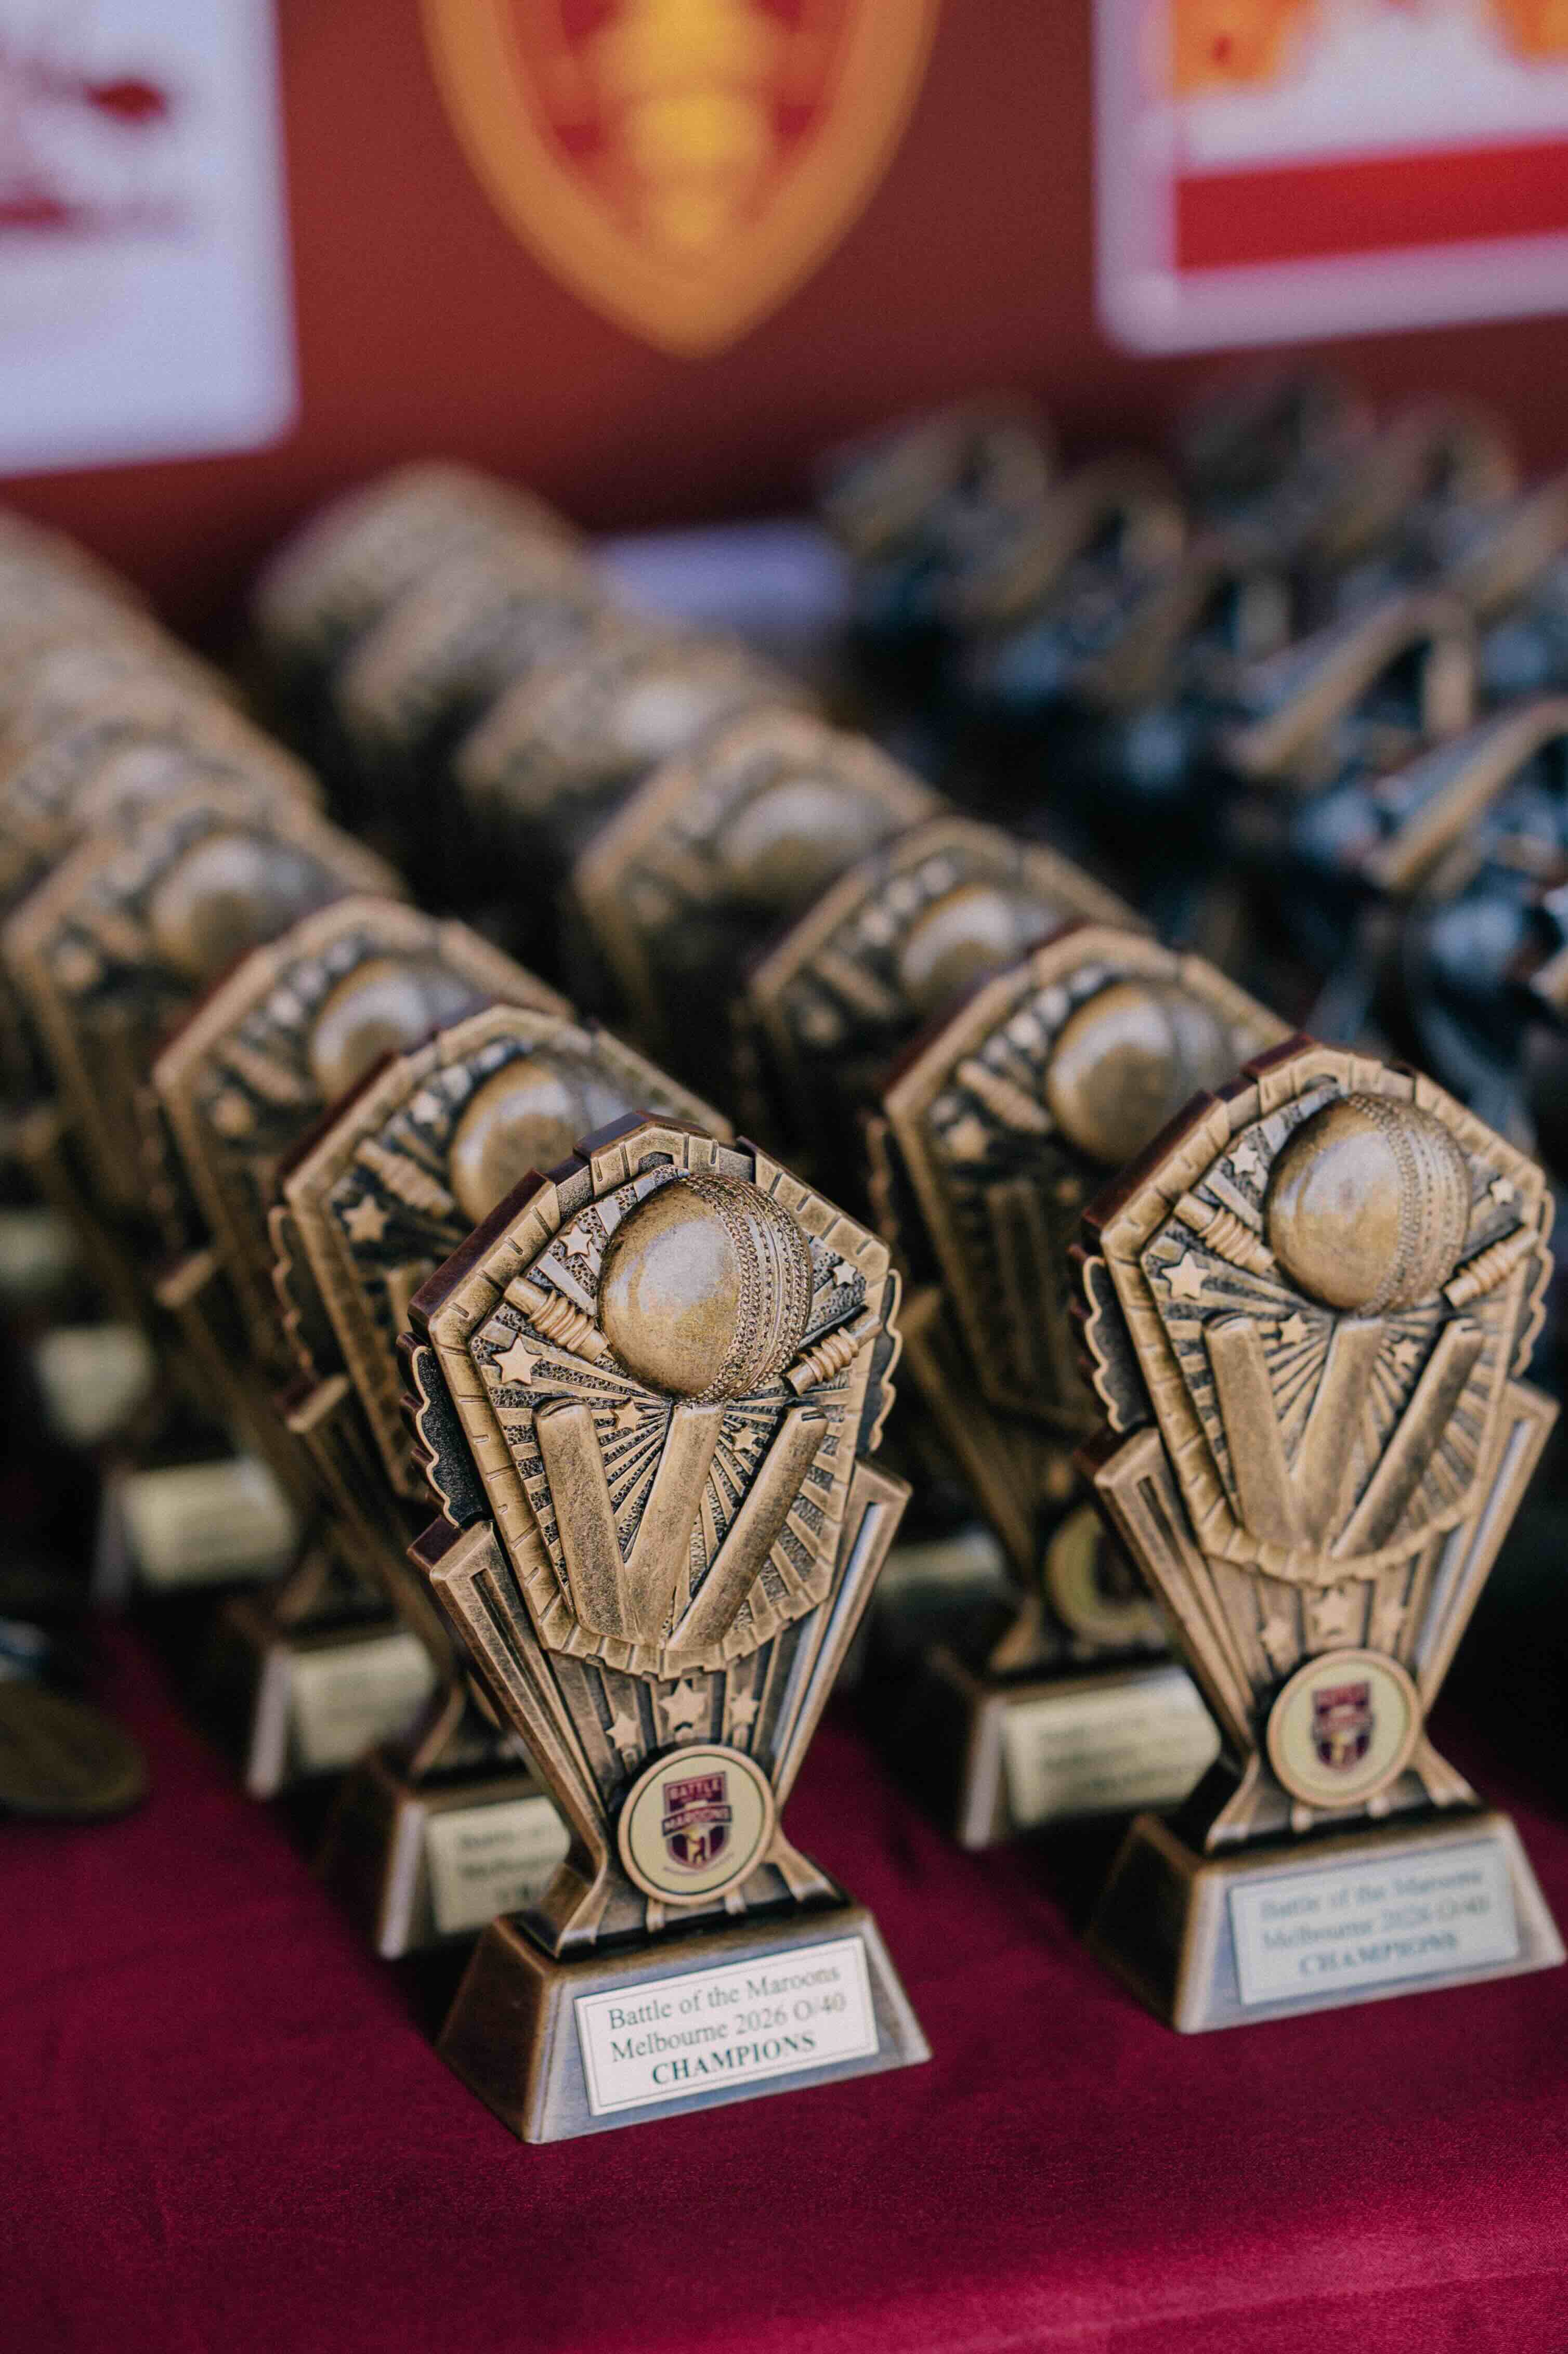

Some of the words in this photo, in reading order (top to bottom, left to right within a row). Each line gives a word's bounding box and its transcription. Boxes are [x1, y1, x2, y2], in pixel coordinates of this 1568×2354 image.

[608, 1999, 673, 2030] Battle
[678, 1988, 703, 2015] of
[707, 1985, 740, 2008] the
[746, 1966, 840, 1999] Maroons
[610, 2020, 729, 2063] Melbourne
[734, 2004, 788, 2036] 2026
[651, 2030, 816, 2086] CHAMPIONS
